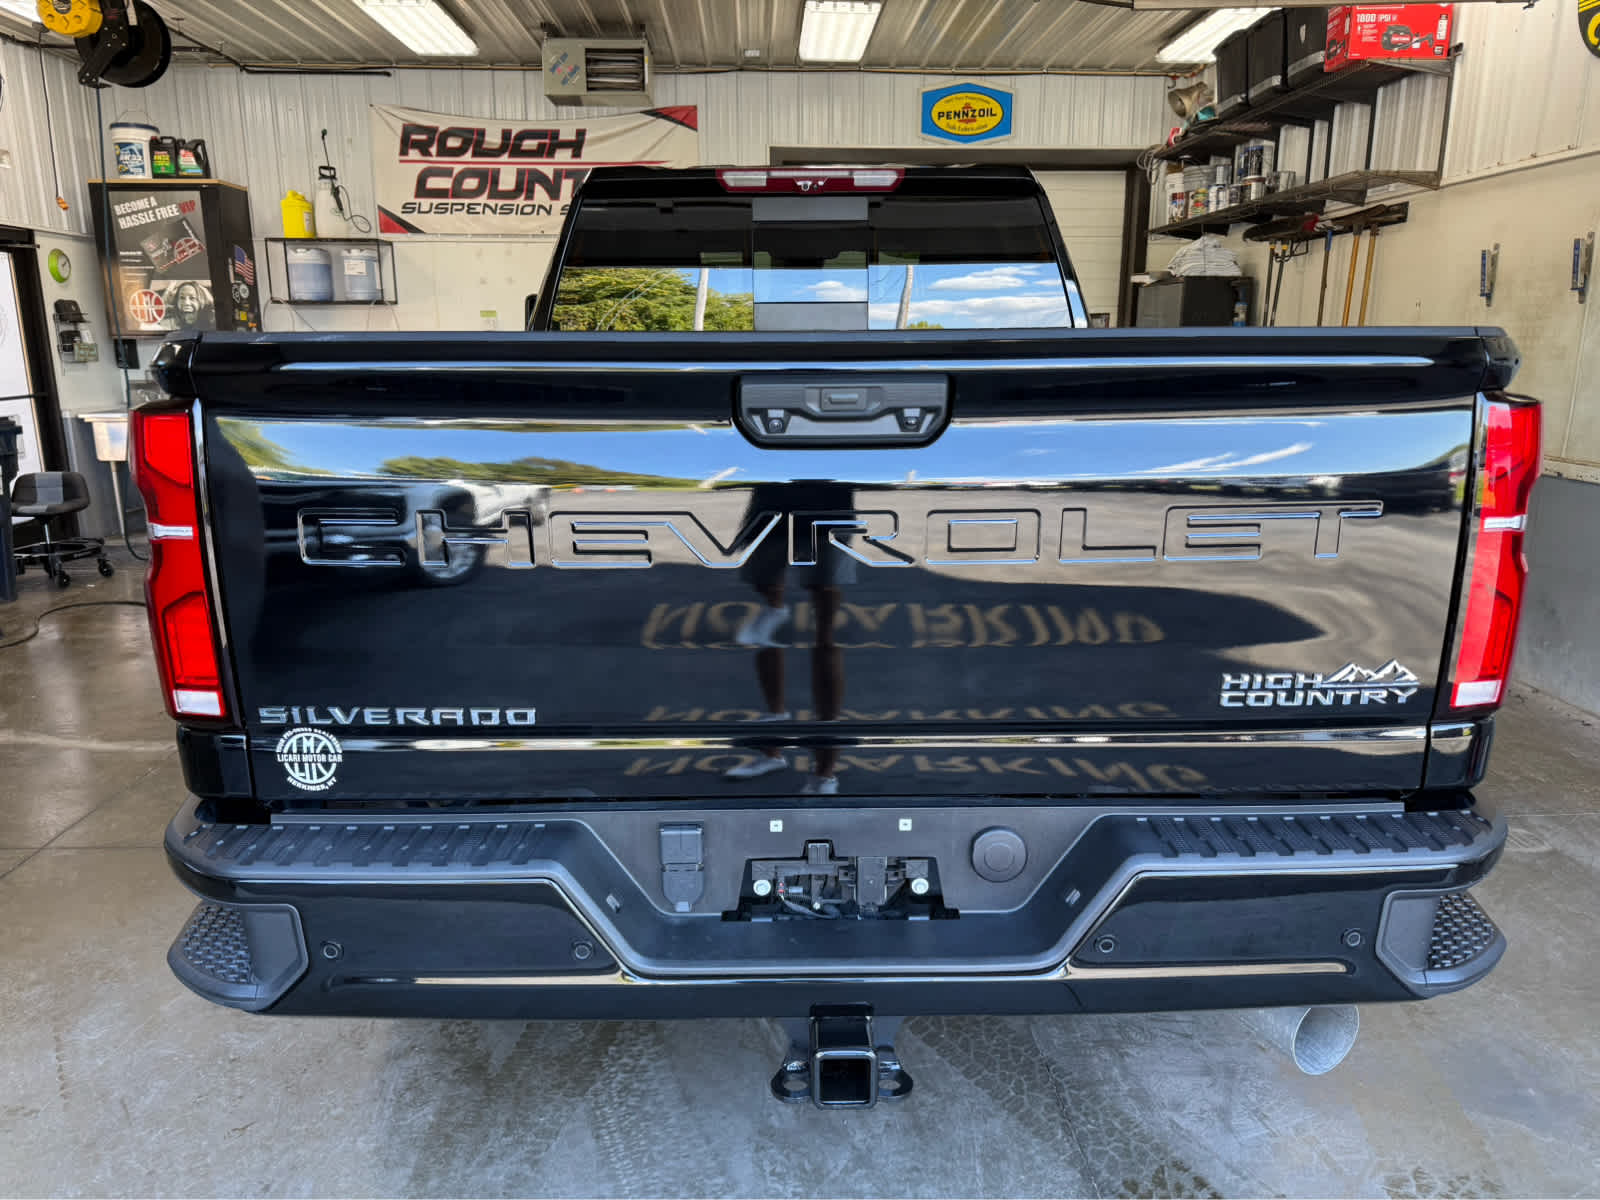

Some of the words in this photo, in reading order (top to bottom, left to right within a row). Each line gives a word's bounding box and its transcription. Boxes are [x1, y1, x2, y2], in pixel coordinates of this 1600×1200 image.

[937, 107, 997, 120] PENNZOIL
[399, 123, 587, 159] ROUGH
[114, 198, 150, 216] BECOME
[149, 195, 158, 207] A
[401, 202, 552, 216] SUSPENSION
[118, 210, 156, 230] HASSLE
[155, 204, 180, 220] FREE
[298, 500, 1384, 568] CHEVROLET
[1221, 672, 1323, 689] HIGH
[1219, 687, 1418, 707] COUNTRY
[258, 706, 536, 726] SILVERADO
[277, 753, 301, 763] LICARI
[302, 753, 327, 763] MOTOR
[328, 753, 343, 763] CAR
